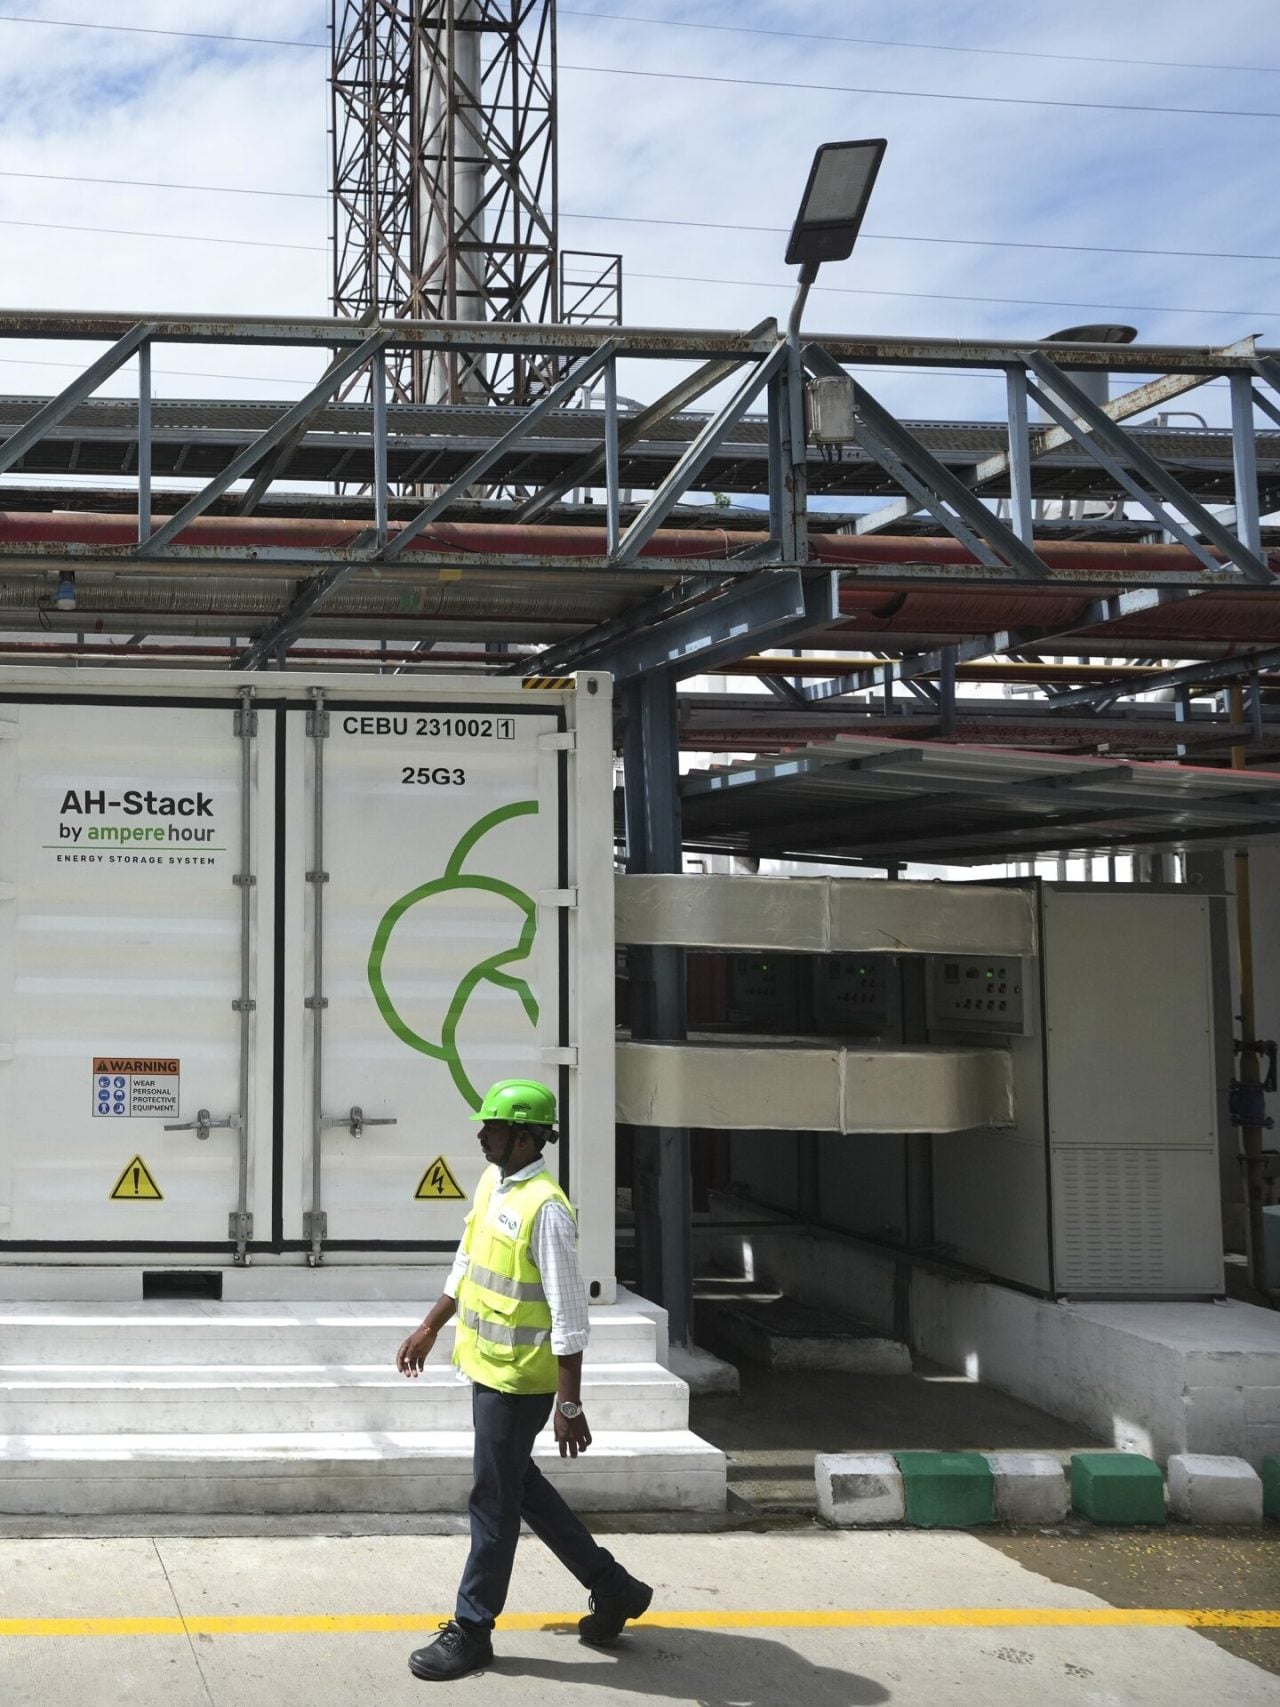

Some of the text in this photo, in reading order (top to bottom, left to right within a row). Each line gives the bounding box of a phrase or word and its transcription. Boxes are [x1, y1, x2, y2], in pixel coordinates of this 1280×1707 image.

[343, 717, 408, 735] CEBU
[416, 719, 493, 737] 231002
[401, 767, 466, 785] 25G3
[60, 790, 214, 816] AH-Stack
[59, 823, 82, 842] by
[109, 856, 163, 864] STORAGE
[169, 857, 215, 865] SYSTEM
[110, 1061, 177, 1072] WARNING
